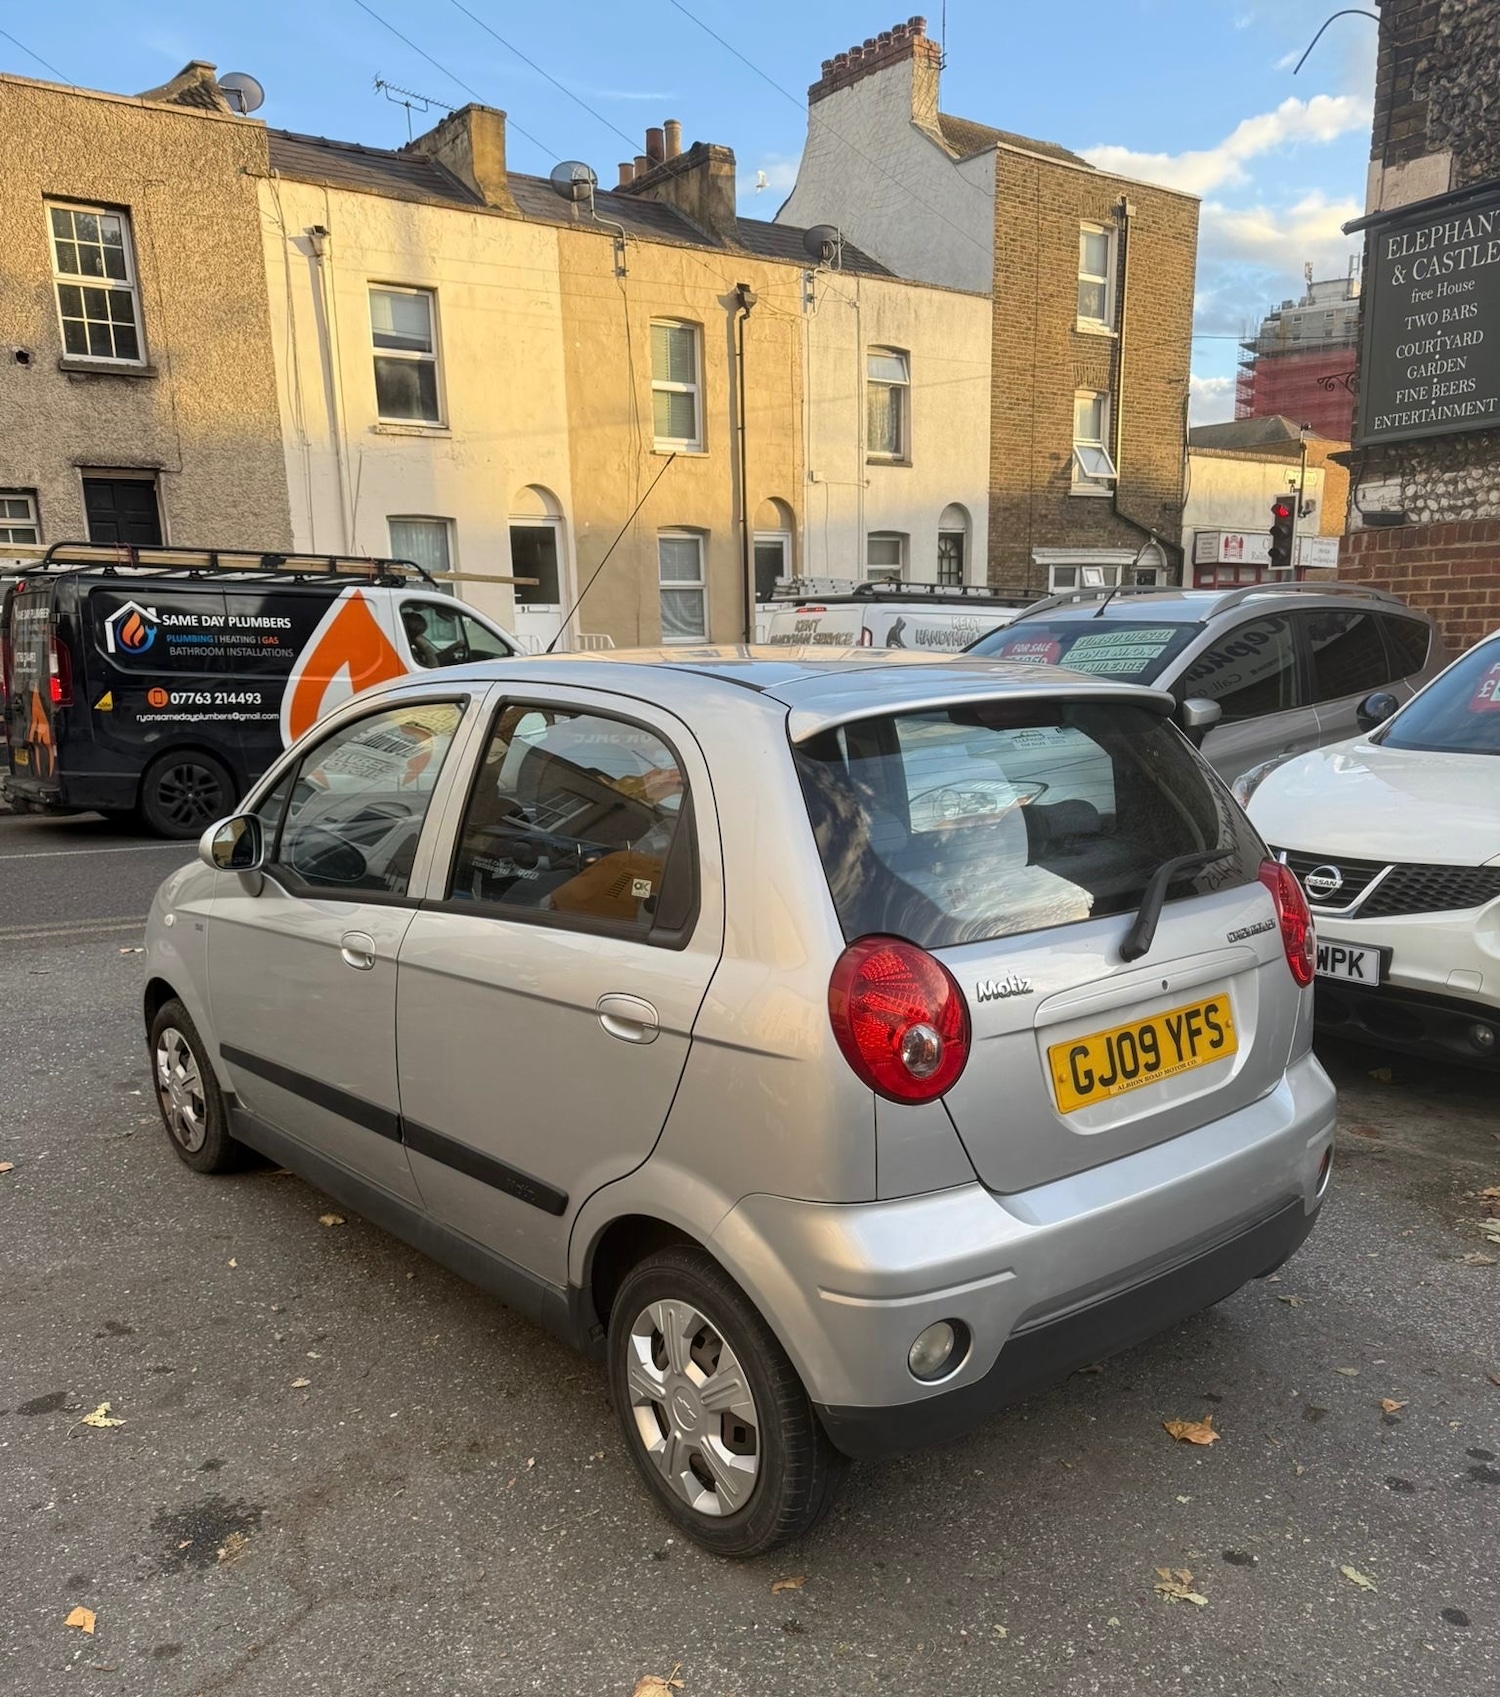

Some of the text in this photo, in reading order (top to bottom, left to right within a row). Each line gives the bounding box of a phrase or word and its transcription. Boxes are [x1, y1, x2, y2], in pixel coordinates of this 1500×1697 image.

[1391, 239, 1500, 286] & CASTLE
[1411, 279, 1476, 303] free House
[1405, 302, 1478, 330] TWO BARS
[1395, 329, 1484, 359] COURTYARD
[1407, 356, 1467, 379] GARDEN
[1396, 378, 1476, 404] FINE BEERS
[1374, 397, 1498, 430] ENTERTAINMENT
[162, 614, 292, 629] SAME DAY PLUMBERS
[166, 634, 279, 645] PLUMBING HEATING GAS
[169, 646, 294, 658] BATHROOM INSTALLATIONS
[1031, 642, 1053, 653] SALE
[170, 691, 262, 705] 07763 214493
[1305, 877, 1338, 887] NISSAN
[1317, 944, 1364, 978] WPK
[1069, 1003, 1224, 1095] GJ09 YFS
[1117, 1077, 1143, 1092] ALBION
[1144, 1071, 1163, 1083] ROAD
[1163, 1063, 1187, 1076] MOTOR
